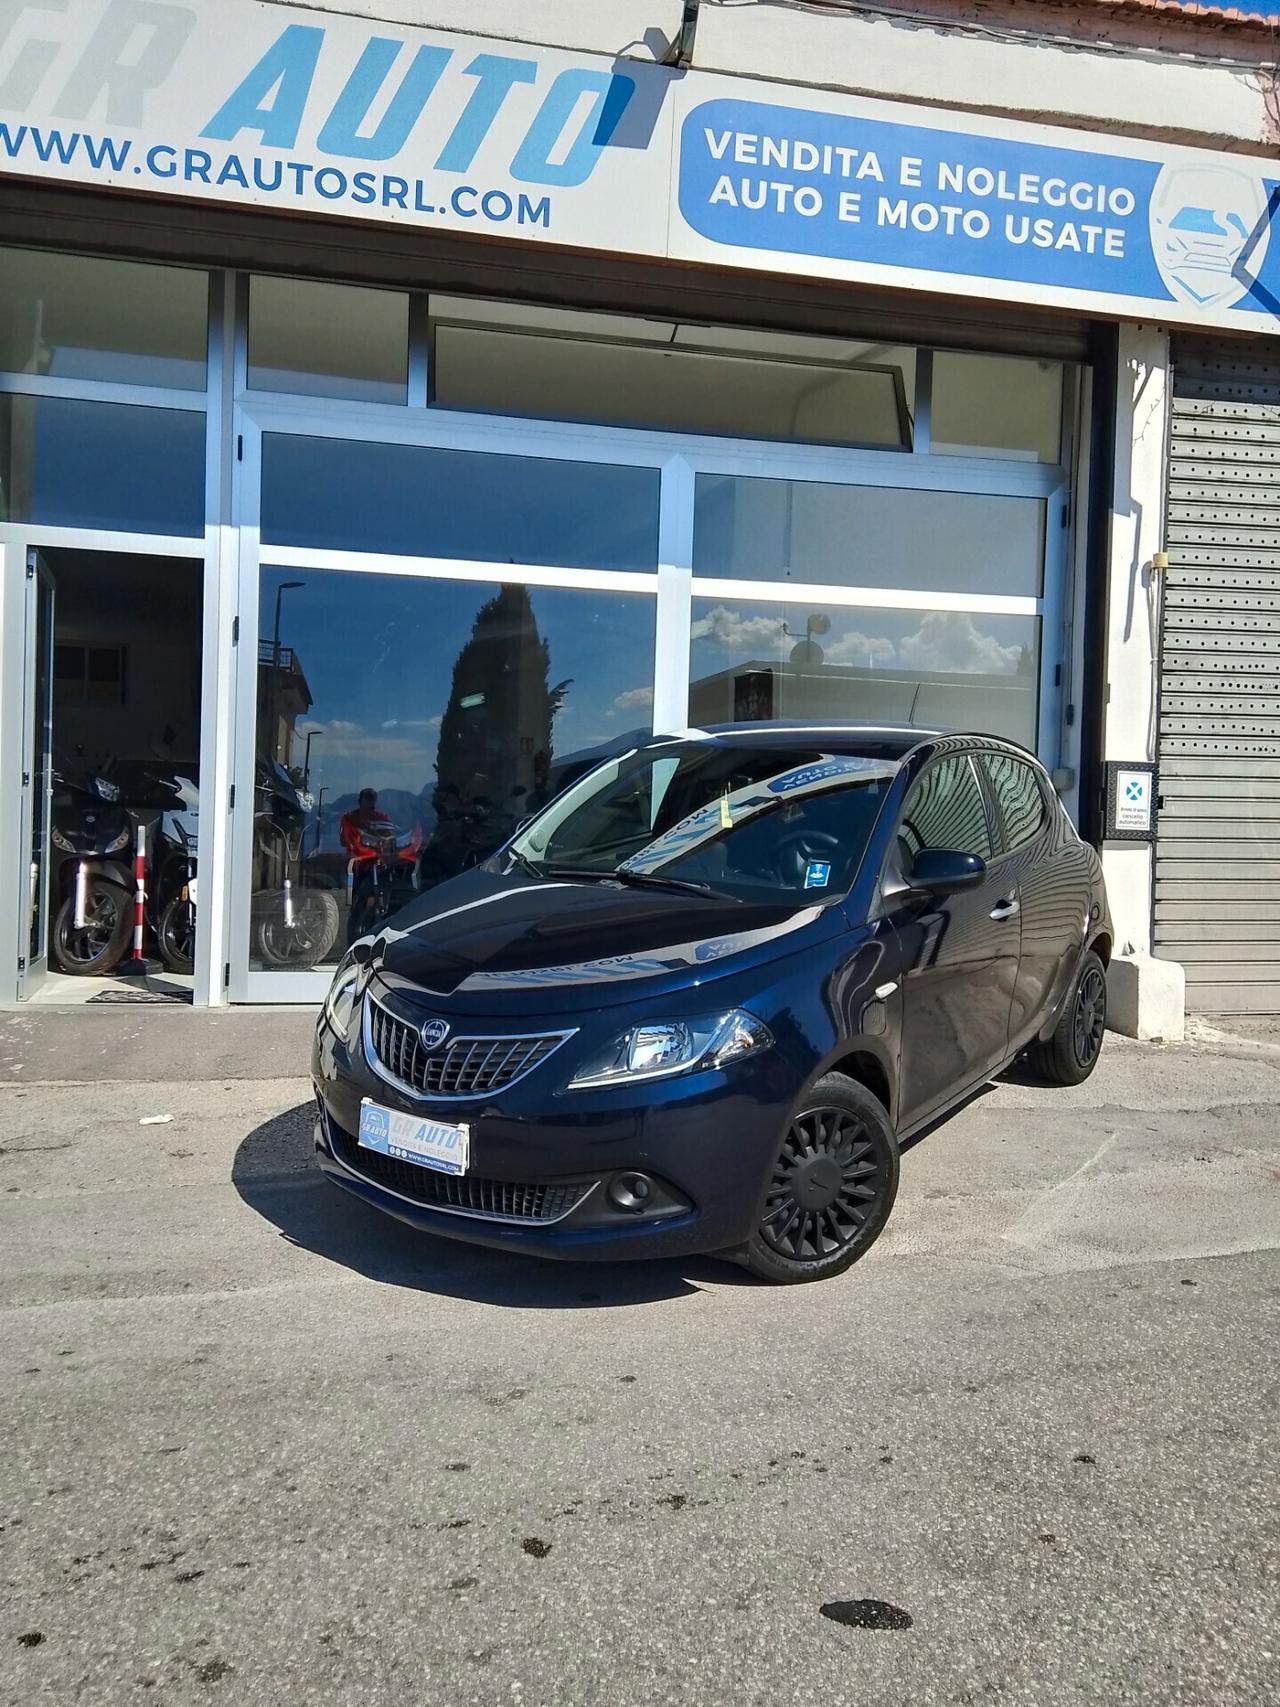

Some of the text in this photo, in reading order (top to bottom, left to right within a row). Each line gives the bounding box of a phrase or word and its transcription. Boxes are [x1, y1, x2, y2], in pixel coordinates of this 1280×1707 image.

[198, 24, 636, 187] AUTO
[705, 128, 1134, 215] VENDITA E NOLEGGIO
[709, 176, 1124, 257] AUTO E MOTO USATE
[415, 1124, 460, 1149] AUTO
